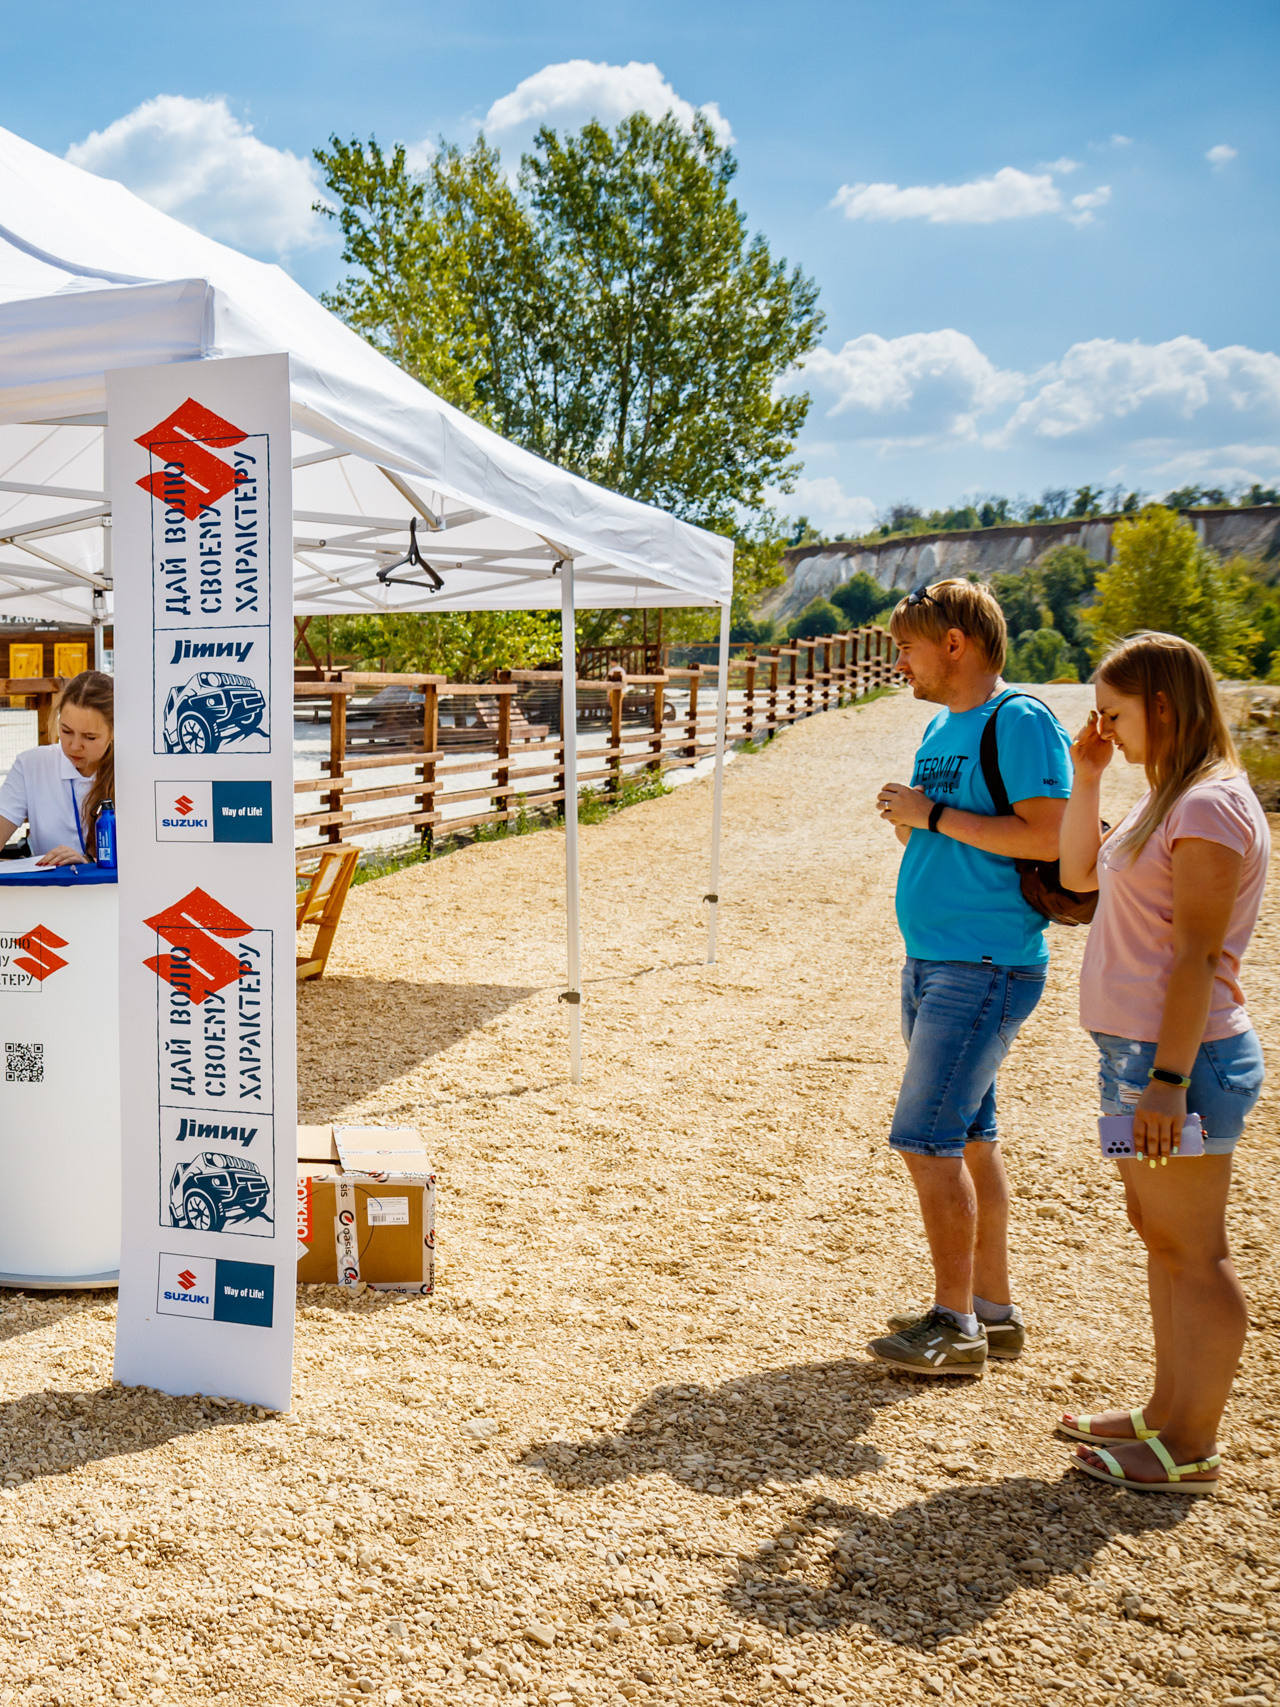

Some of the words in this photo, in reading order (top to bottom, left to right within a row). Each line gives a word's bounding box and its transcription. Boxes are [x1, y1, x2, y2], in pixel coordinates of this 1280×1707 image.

[164, 462, 186, 543] ВОЛЮ
[199, 503, 222, 614] СВОЕМУ
[234, 451, 258, 612] ХАРАКТЕРУ
[160, 557, 191, 615] ДАЙ
[170, 640, 254, 664] Jimny
[915, 755, 969, 782] TERMIT
[162, 819, 208, 827] SUZUKI
[222, 806, 237, 818] Way
[238, 806, 246, 816] of
[247, 806, 263, 816] Life!
[170, 946, 191, 1025] ВОЛЮ
[204, 989, 226, 1097] СВОЕМУ
[239, 942, 261, 1100] ХАРАКТЕРУ
[165, 1039, 195, 1096] ДАЙ
[176, 1118, 258, 1147] Jimny
[297, 1177, 309, 1239] РОЖНО
[163, 1291, 210, 1304] SUZUKI
[224, 1285, 239, 1298] Way
[240, 1288, 248, 1297] of
[248, 1288, 265, 1299] Life!
